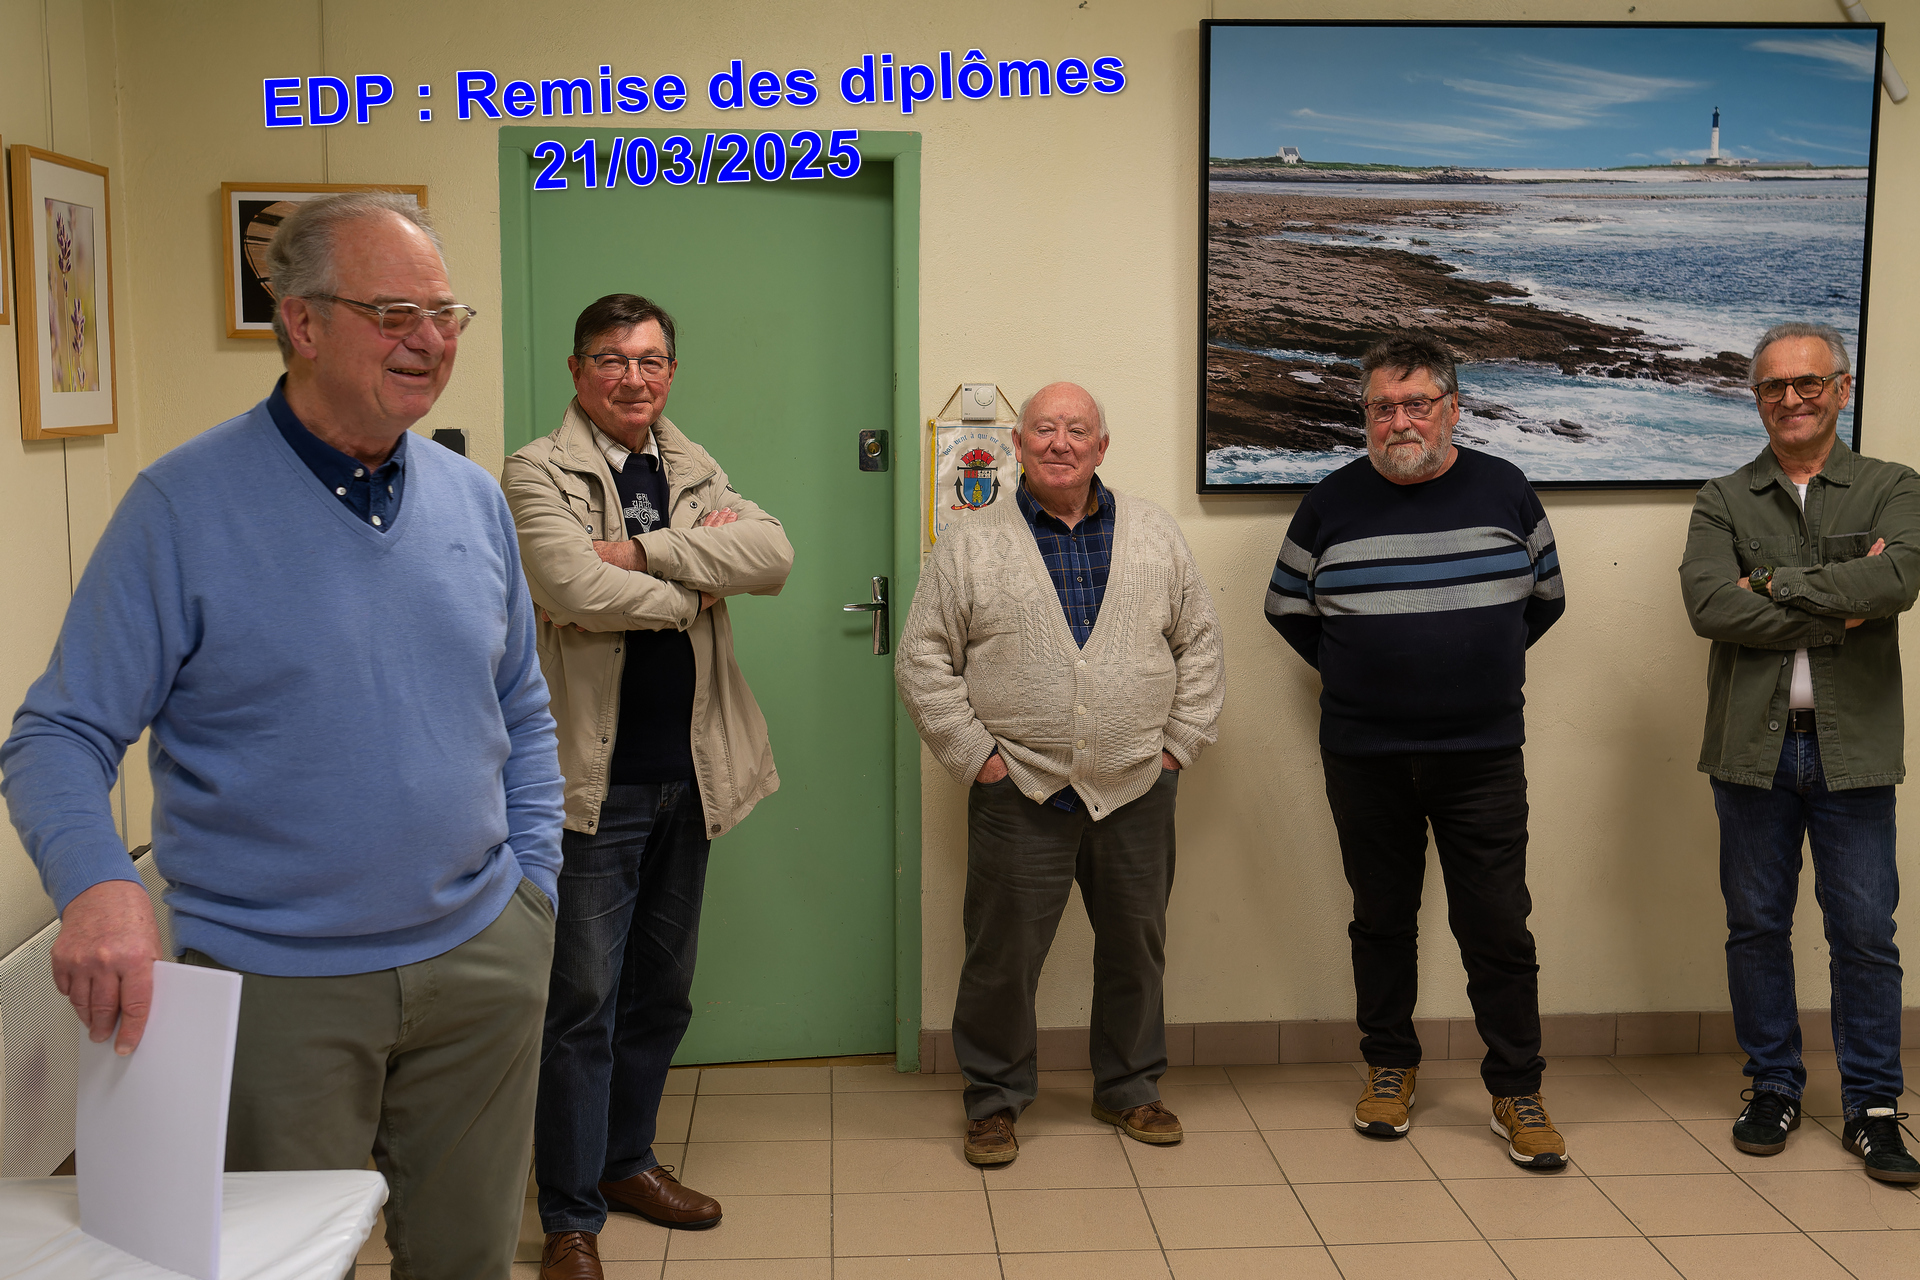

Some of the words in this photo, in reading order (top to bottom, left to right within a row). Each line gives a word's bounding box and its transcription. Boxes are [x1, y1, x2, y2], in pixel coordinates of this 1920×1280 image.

[943, 444, 954, 456] bon
[954, 435, 967, 445] vent
[990, 436, 999, 444] me
